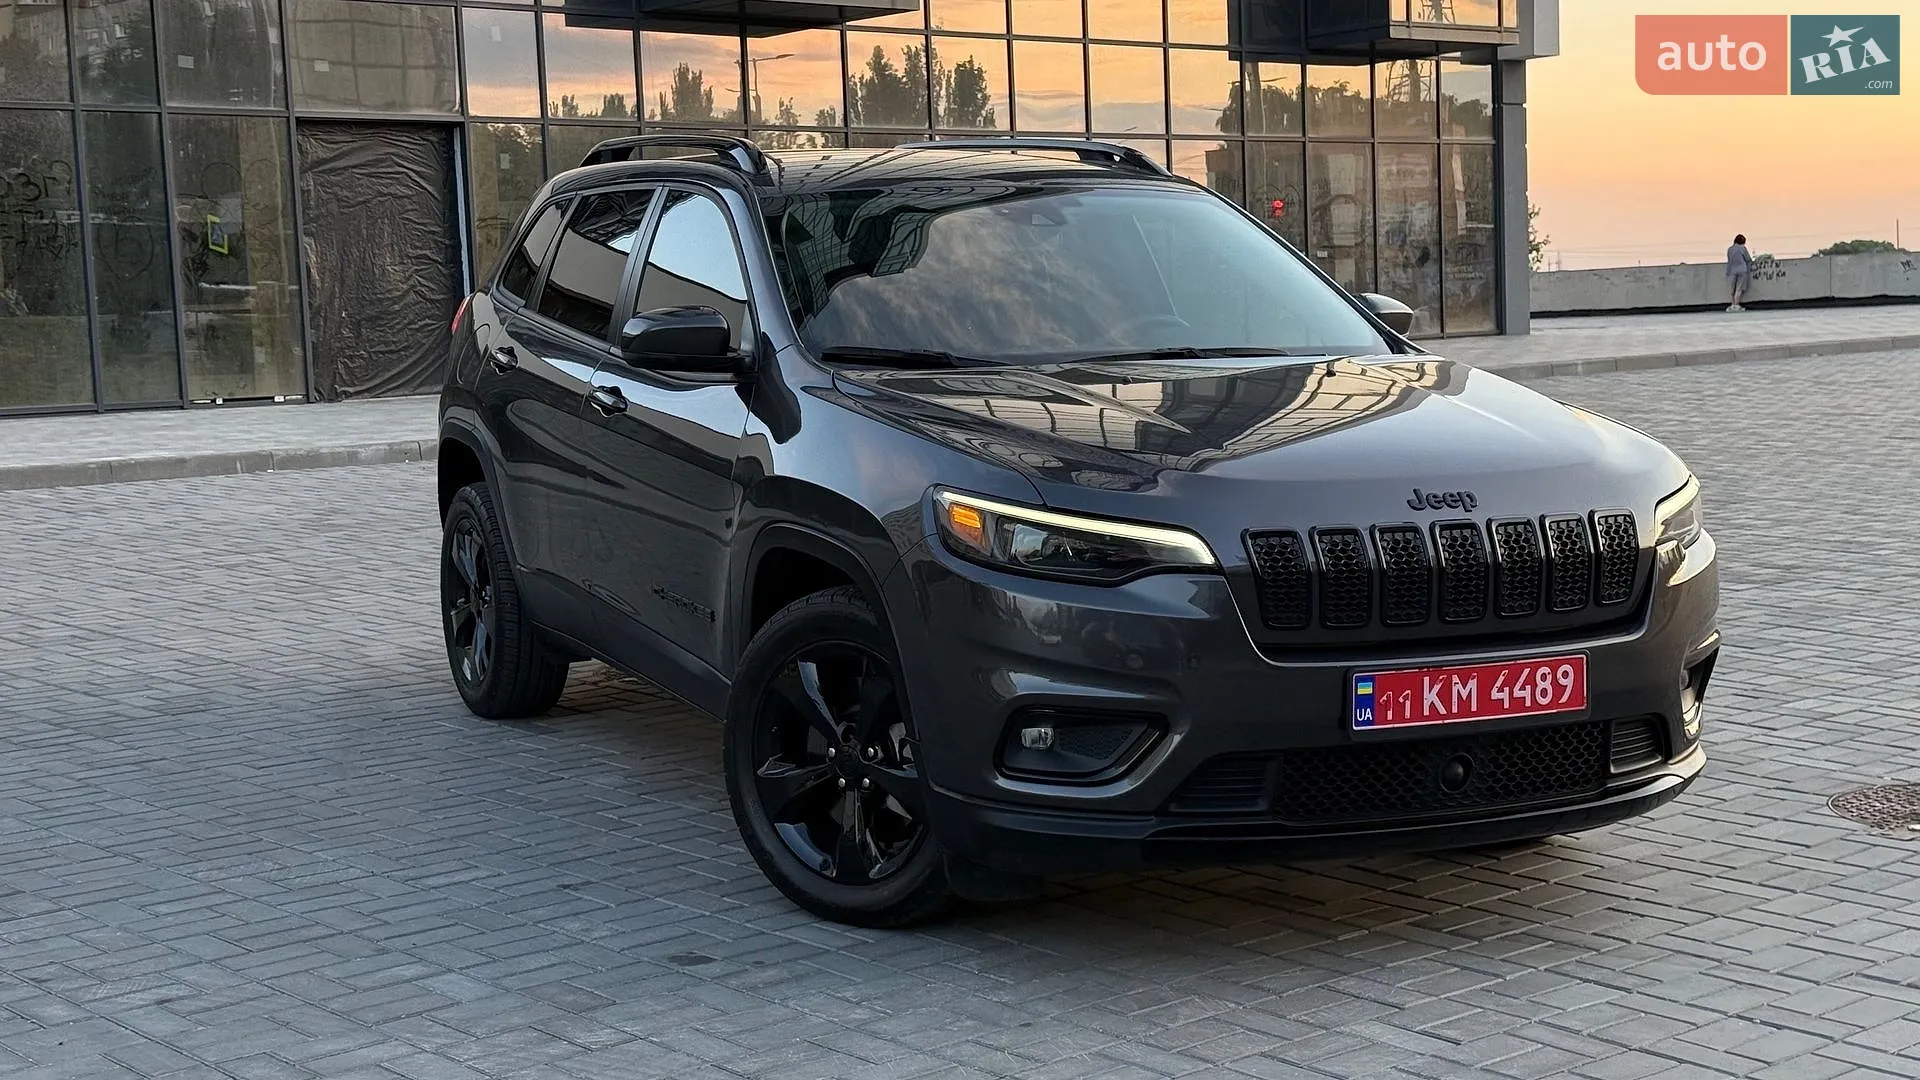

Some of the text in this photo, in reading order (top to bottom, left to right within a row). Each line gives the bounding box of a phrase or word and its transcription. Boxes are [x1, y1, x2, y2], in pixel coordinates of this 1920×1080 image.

[1406, 488, 1478, 513] Jeep
[1491, 664, 1575, 710] 4489
[1356, 707, 1373, 722] UA
